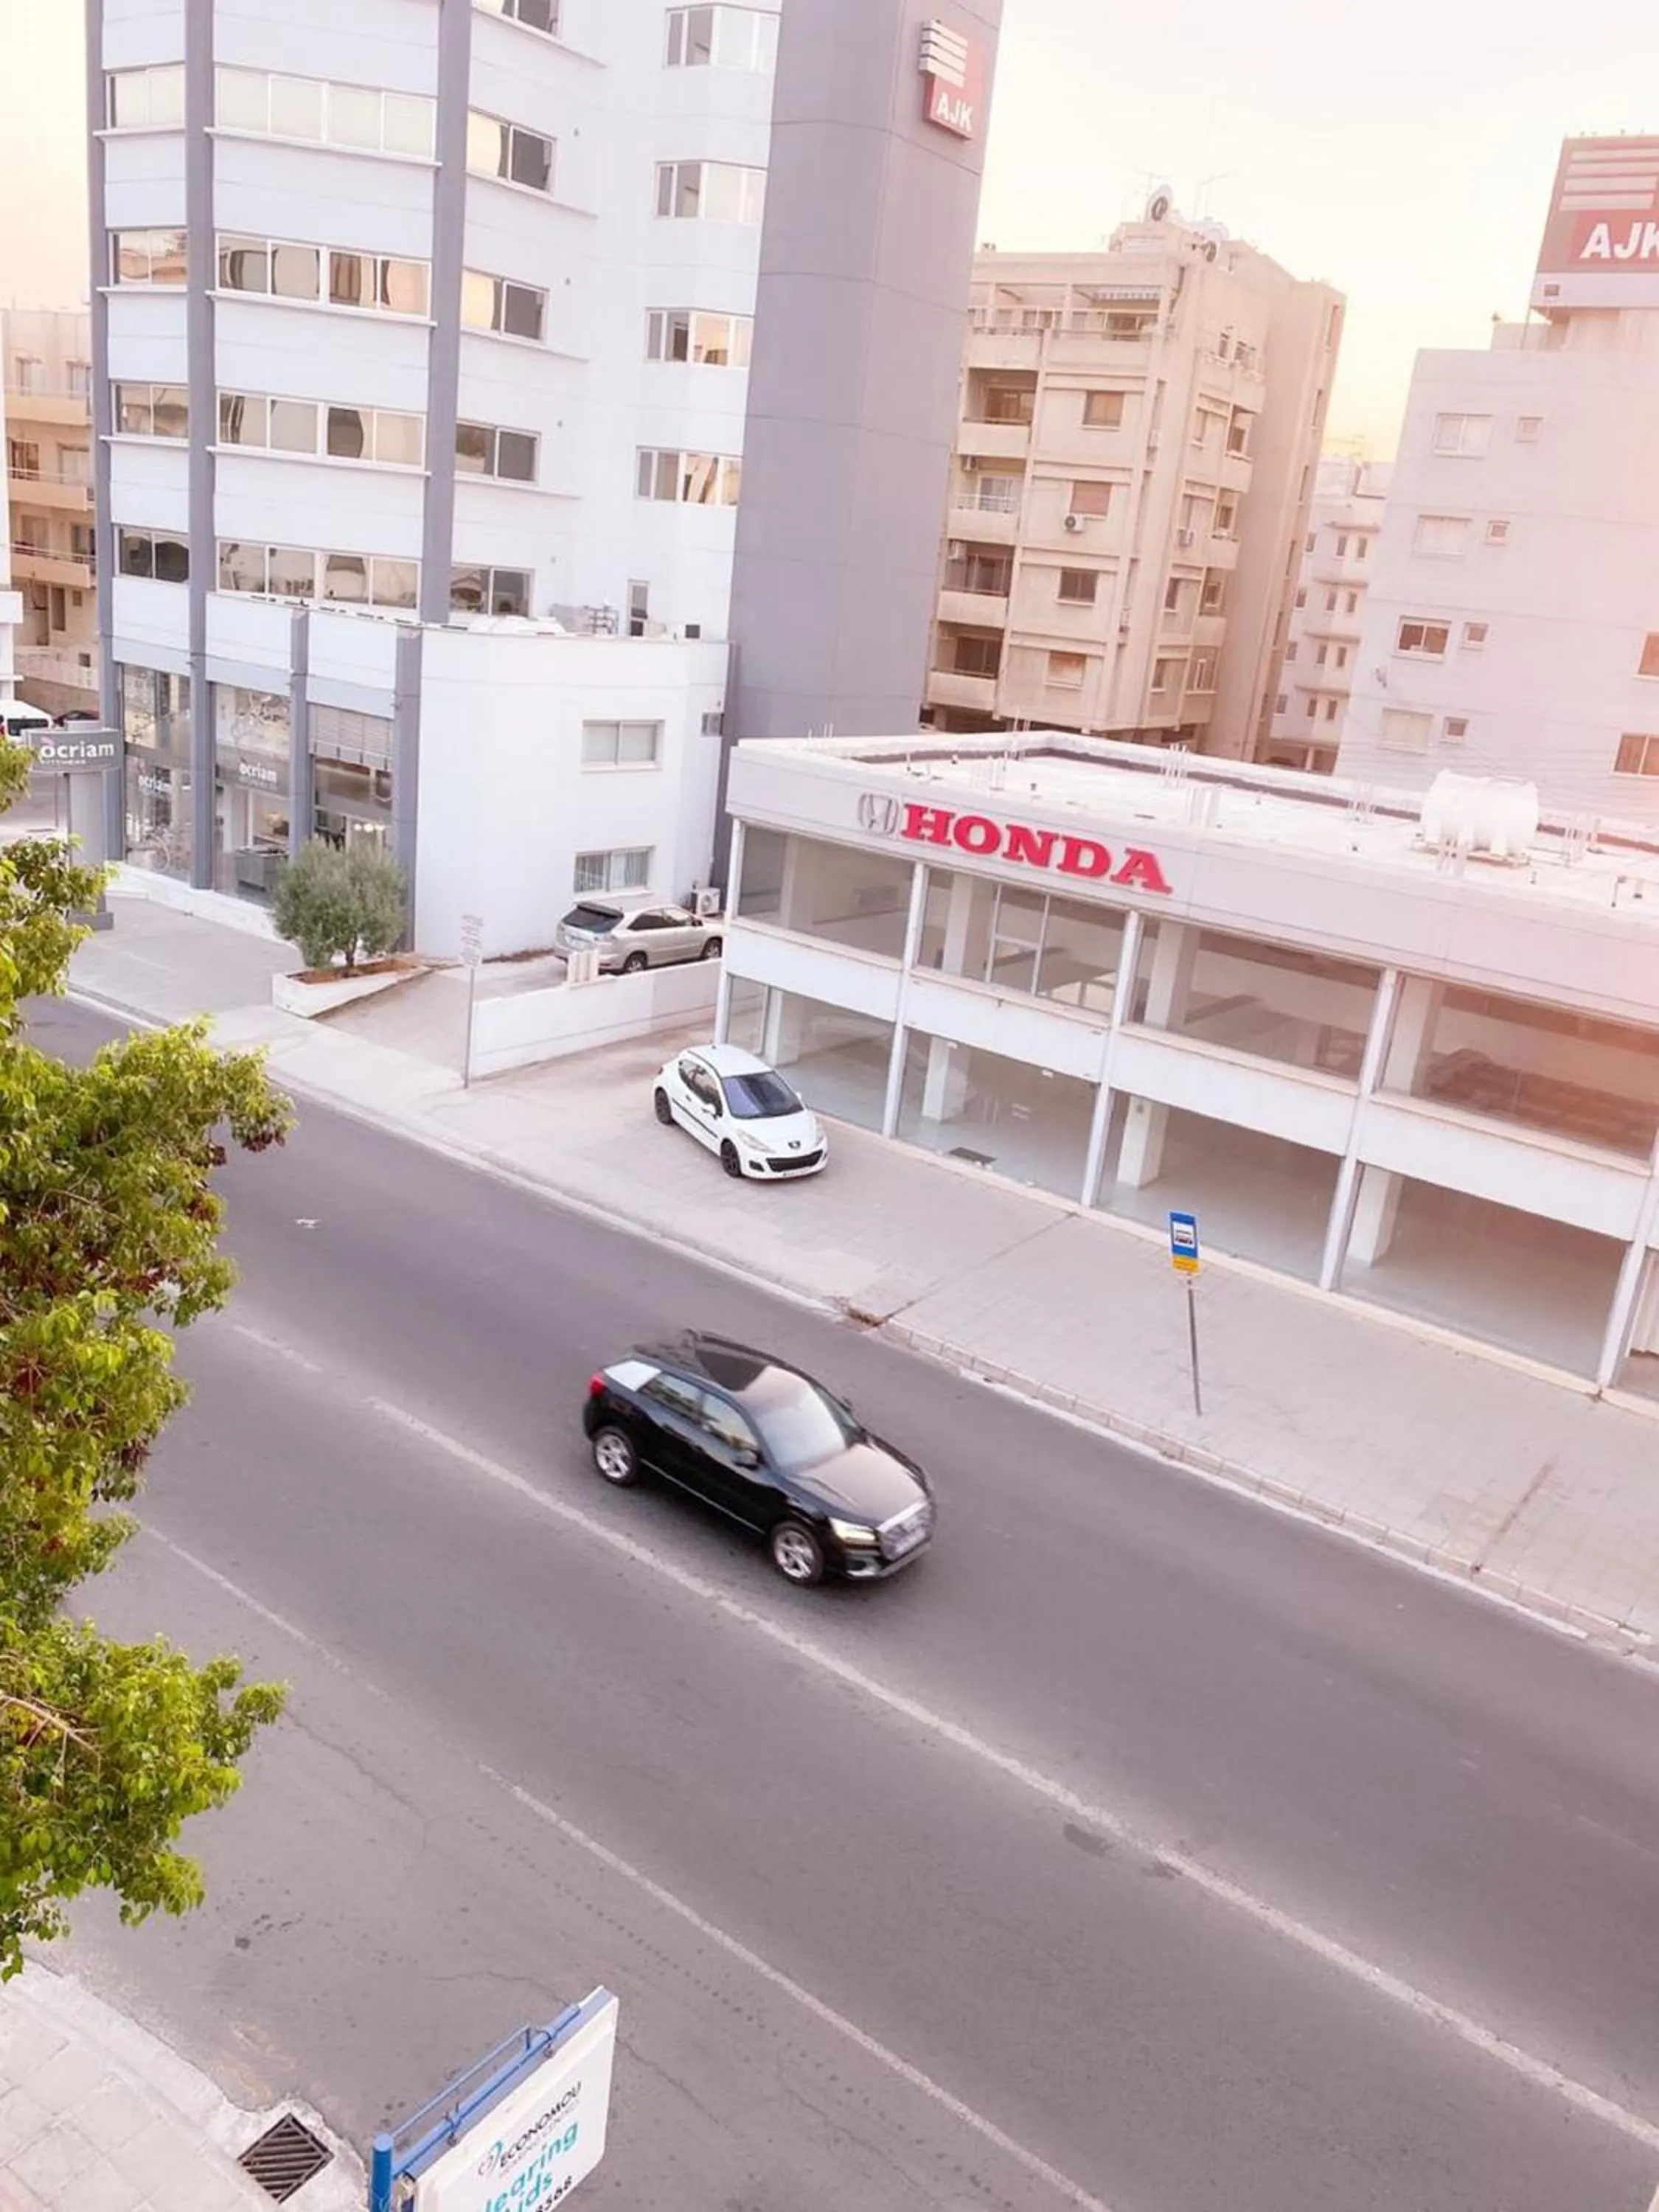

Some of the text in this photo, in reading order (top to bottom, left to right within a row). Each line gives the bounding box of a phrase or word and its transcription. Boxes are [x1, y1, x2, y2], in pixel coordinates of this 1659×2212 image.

[936, 91, 973, 132] AJK
[1579, 222, 1659, 259] AJK
[901, 802, 1173, 894] HONDA
[501, 2081, 581, 2168] ECONOMOU
[484, 2121, 578, 2212] earing
[504, 2171, 552, 2212] ids
